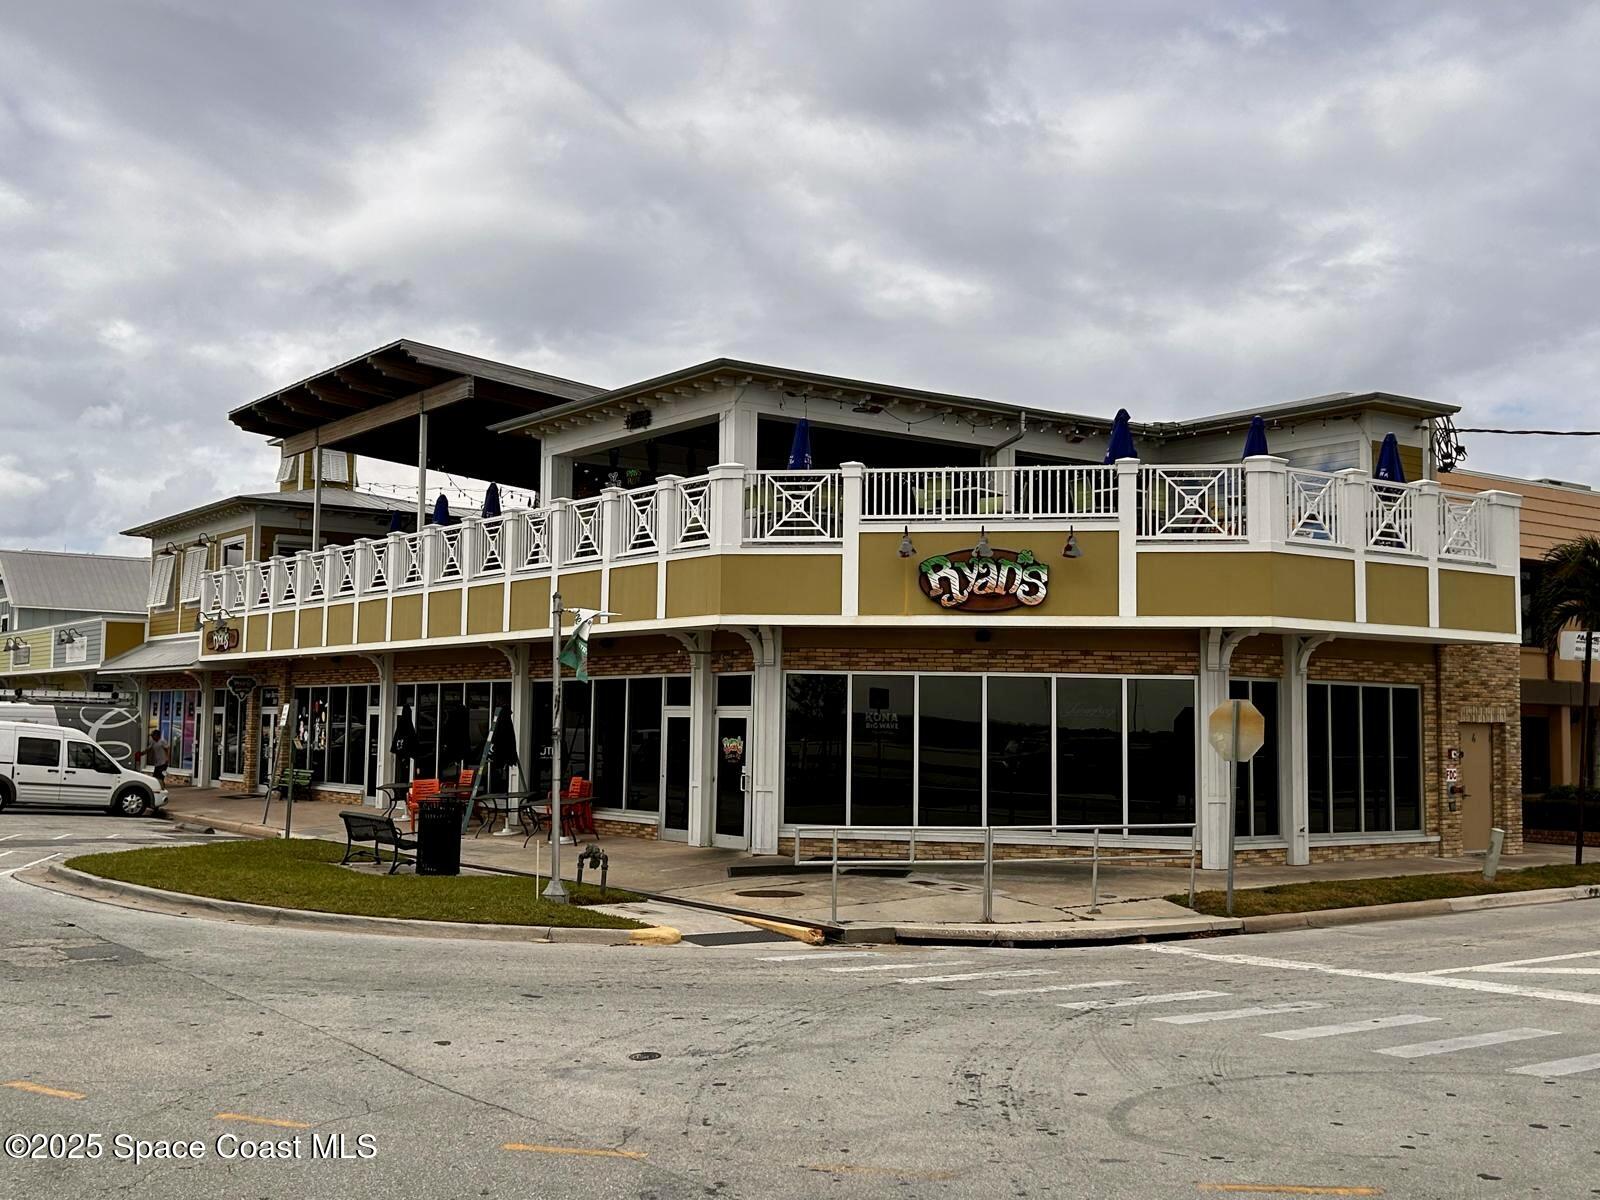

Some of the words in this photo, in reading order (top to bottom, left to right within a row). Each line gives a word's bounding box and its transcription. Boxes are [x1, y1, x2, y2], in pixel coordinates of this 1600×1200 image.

[864, 711, 899, 721] KONA
[879, 722, 900, 730] WAVE
[1446, 769, 1457, 780] FDC
